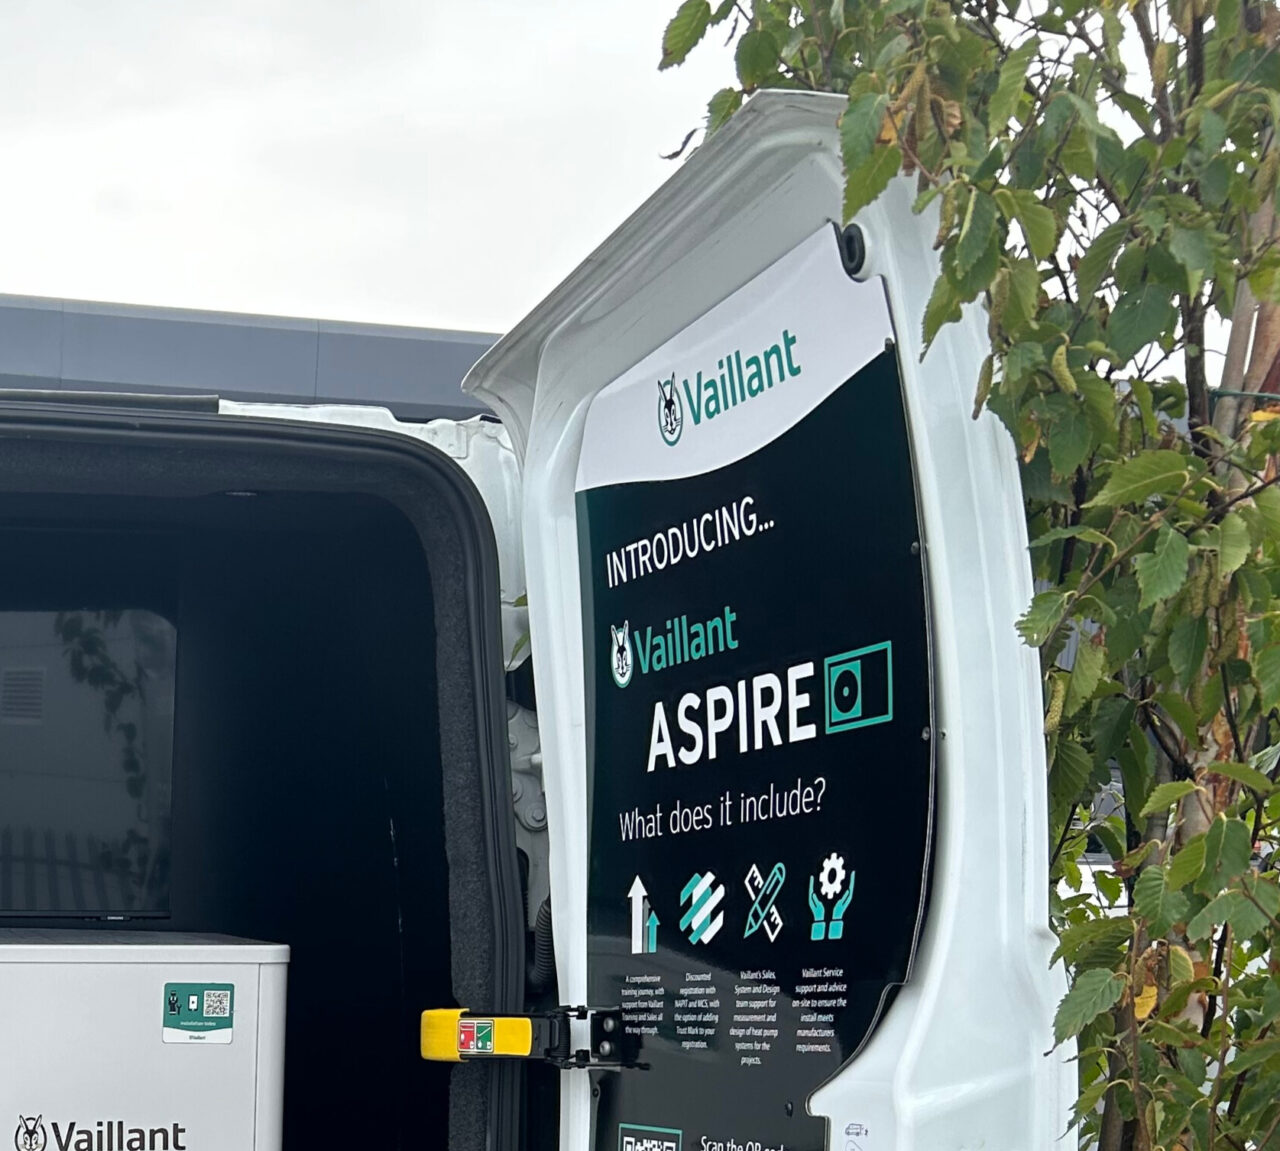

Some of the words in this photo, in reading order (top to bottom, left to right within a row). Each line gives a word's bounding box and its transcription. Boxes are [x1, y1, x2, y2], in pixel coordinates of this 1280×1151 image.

[683, 329, 801, 425] Vaillant
[634, 606, 739, 674] Vaillant
[647, 661, 817, 772] ASPIRE
[620, 803, 663, 842] What
[670, 800, 713, 834] does
[720, 791, 732, 827] it
[740, 777, 826, 823] include?
